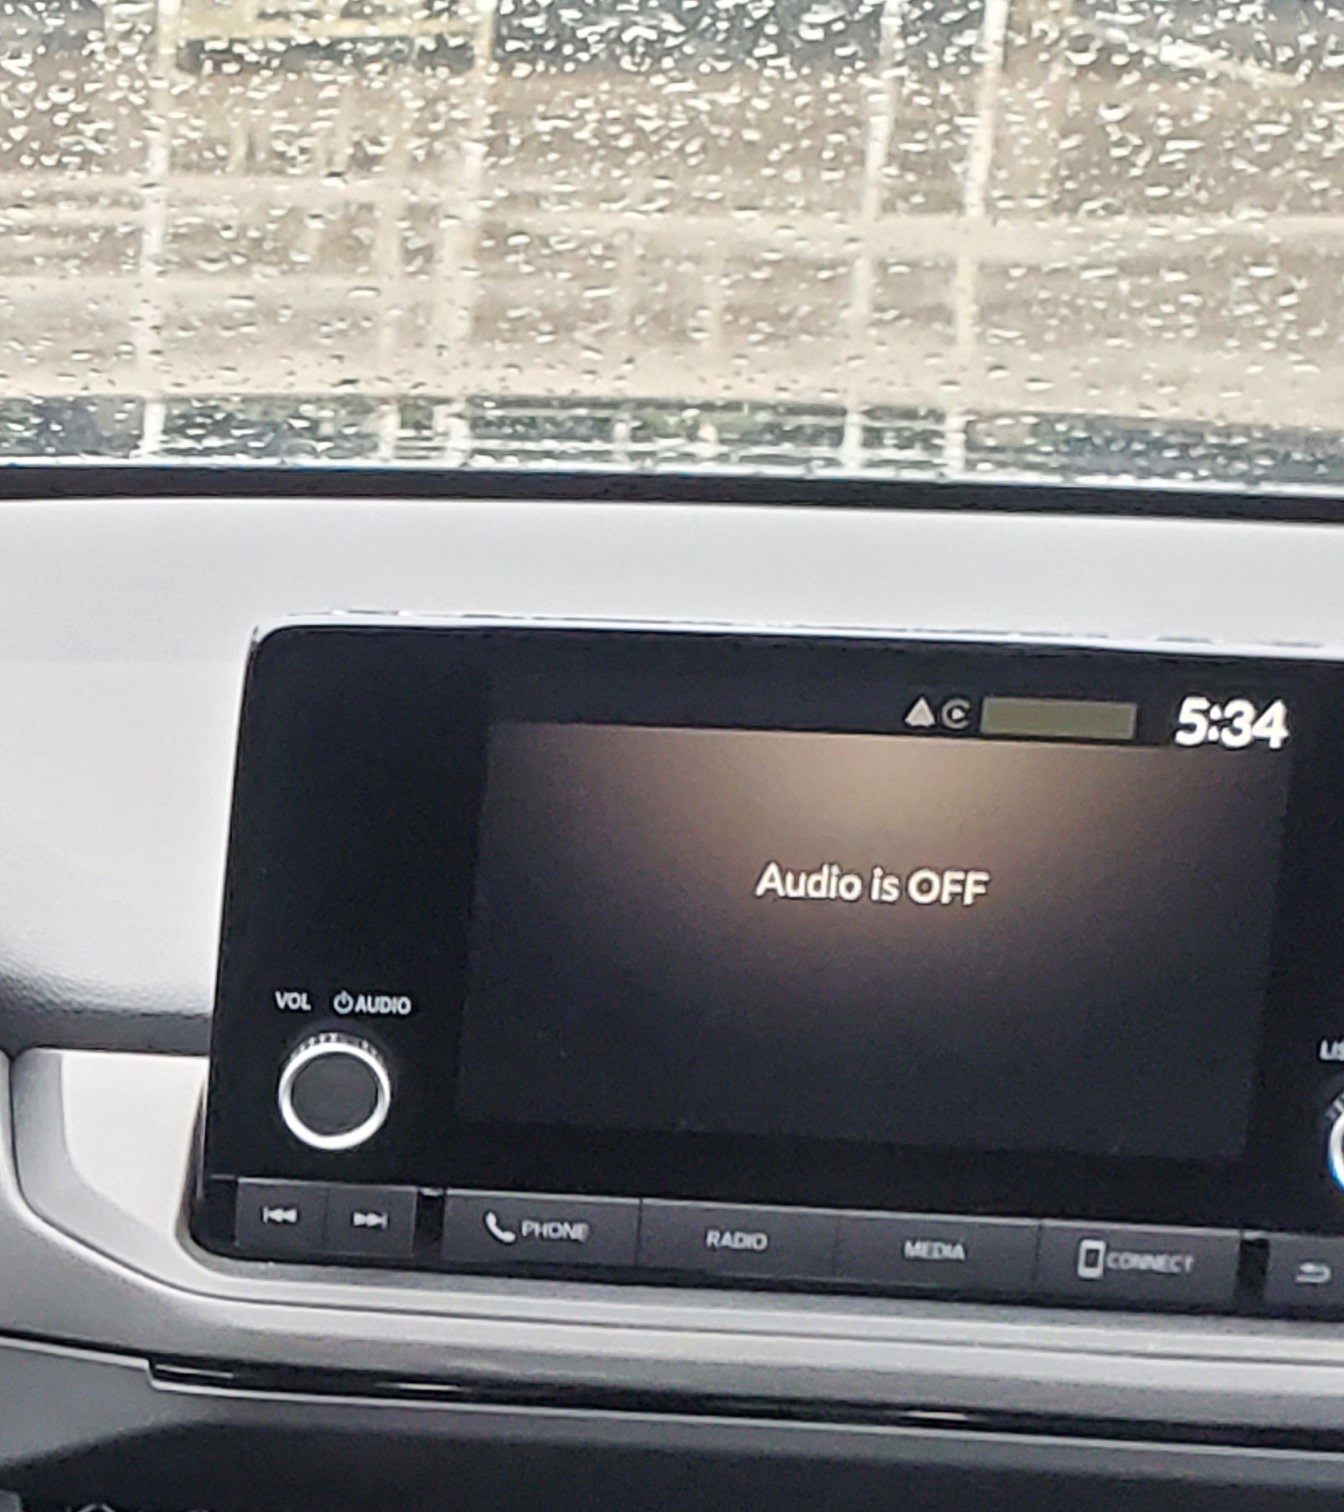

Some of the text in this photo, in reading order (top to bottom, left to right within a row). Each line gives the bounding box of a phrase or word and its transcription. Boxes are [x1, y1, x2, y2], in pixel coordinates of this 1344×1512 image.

[1175, 697, 1290, 750] 5:34
[756, 862, 991, 907] Audio is OFF
[275, 991, 311, 1011] VOL
[354, 994, 411, 1015] AUDIO
[521, 1219, 590, 1242] PHONE
[706, 1229, 769, 1252] RADIO
[904, 1239, 965, 1262] MEDIA
[1107, 1250, 1194, 1274] CONNECT
